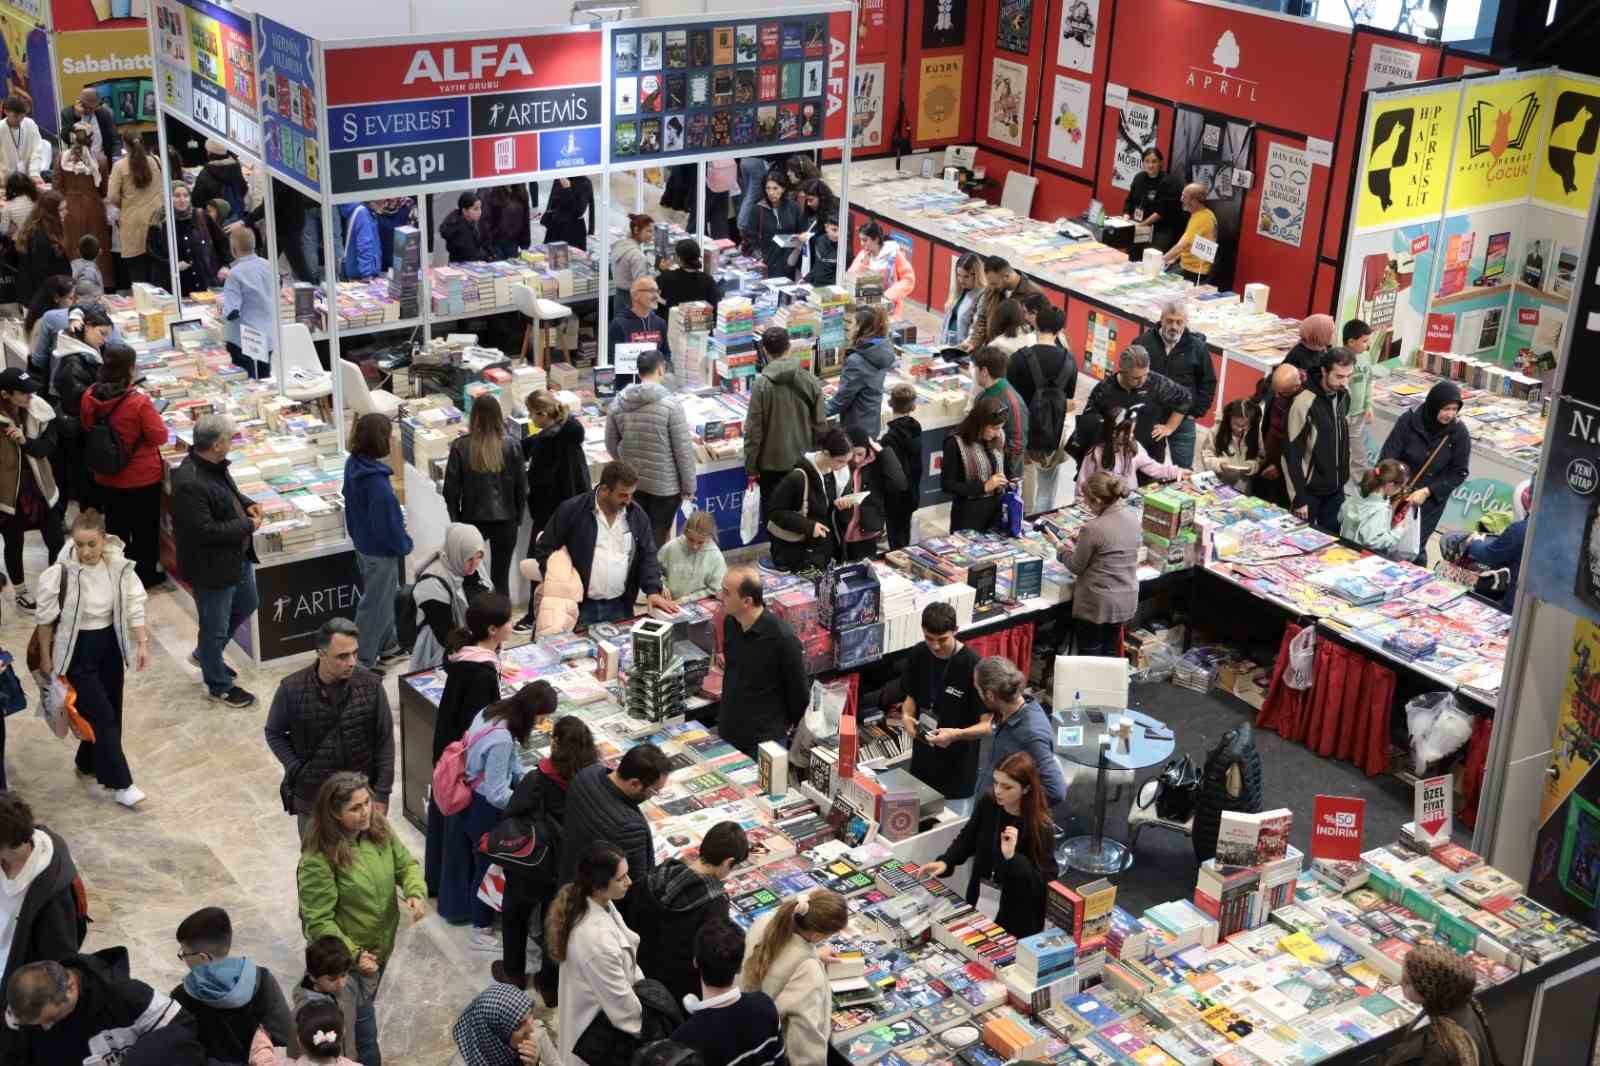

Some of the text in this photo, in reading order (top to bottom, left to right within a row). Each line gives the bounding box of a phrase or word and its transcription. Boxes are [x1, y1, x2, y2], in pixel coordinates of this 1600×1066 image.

[402, 43, 533, 88] ALFA
[826, 37, 846, 117] ALFA
[1186, 72, 1256, 103] APRIL
[506, 94, 588, 128] ARTEMİS
[384, 150, 446, 182] kapı
[1423, 786, 1445, 801] ÖZEL
[1423, 799, 1445, 812] FİYAT
[1316, 824, 1358, 839] İNDİRİM
